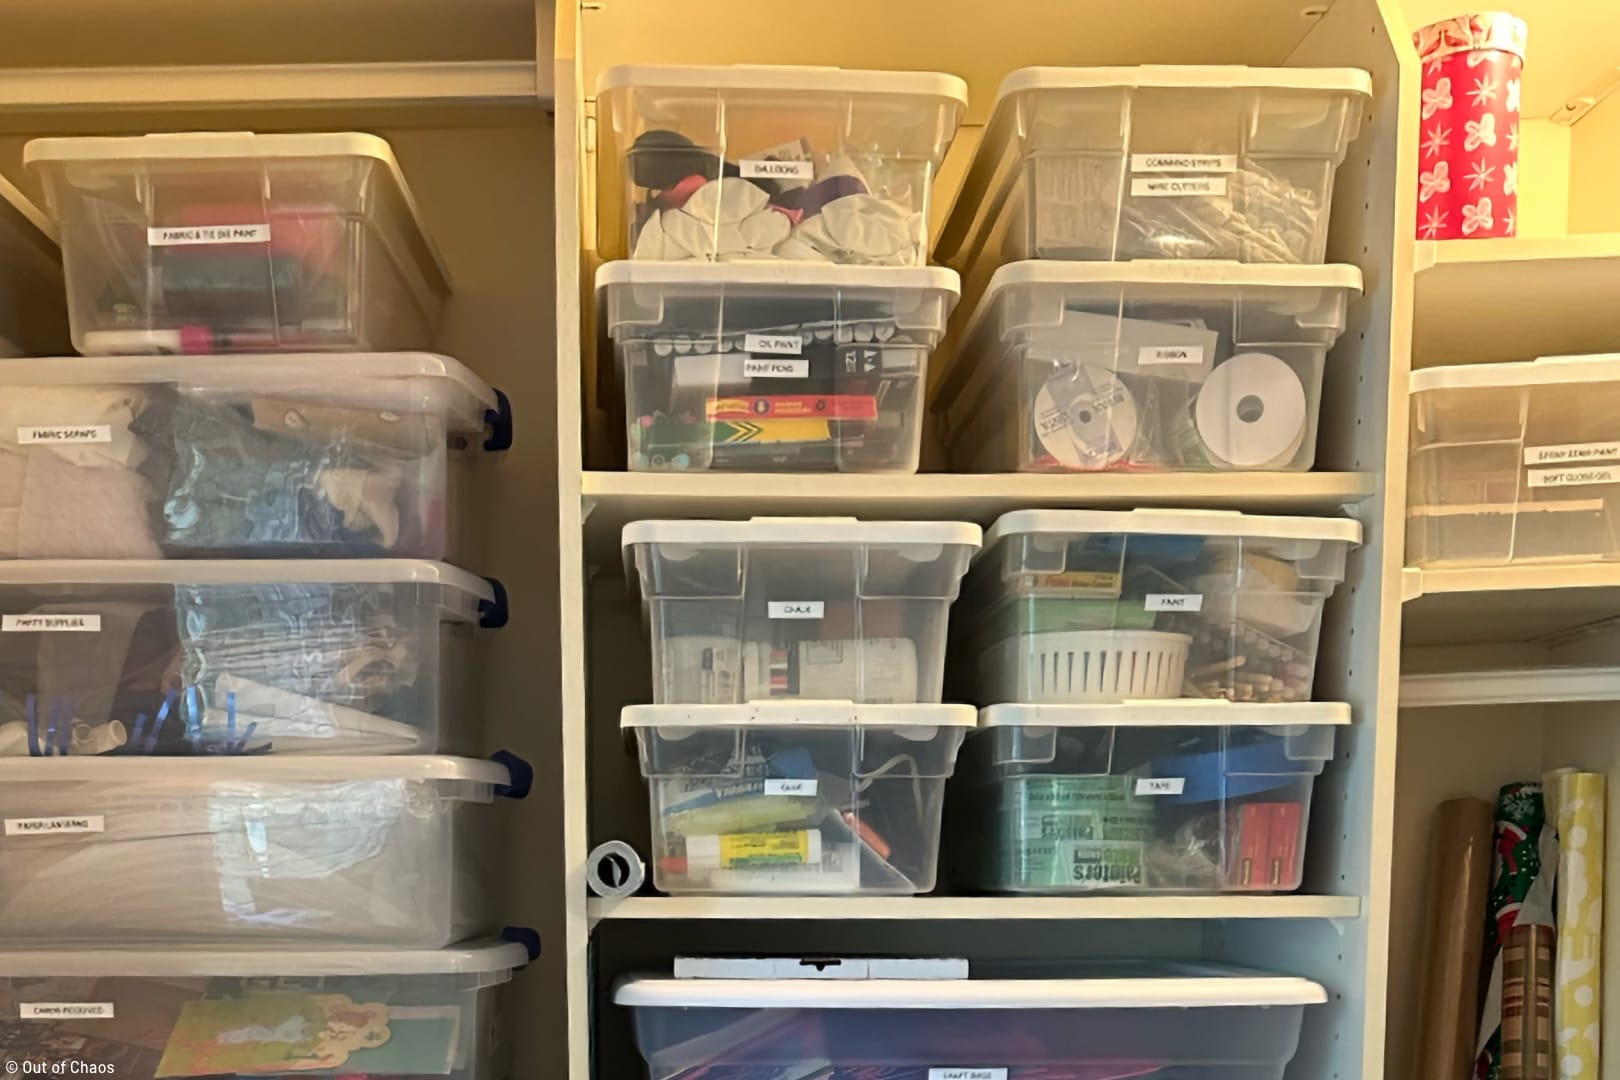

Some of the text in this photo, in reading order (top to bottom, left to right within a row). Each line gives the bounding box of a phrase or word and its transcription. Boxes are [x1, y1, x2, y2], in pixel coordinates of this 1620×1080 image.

[163, 230, 194, 241] FABRIC
[233, 228, 257, 238] PAINT
[774, 340, 801, 350] PAINT
